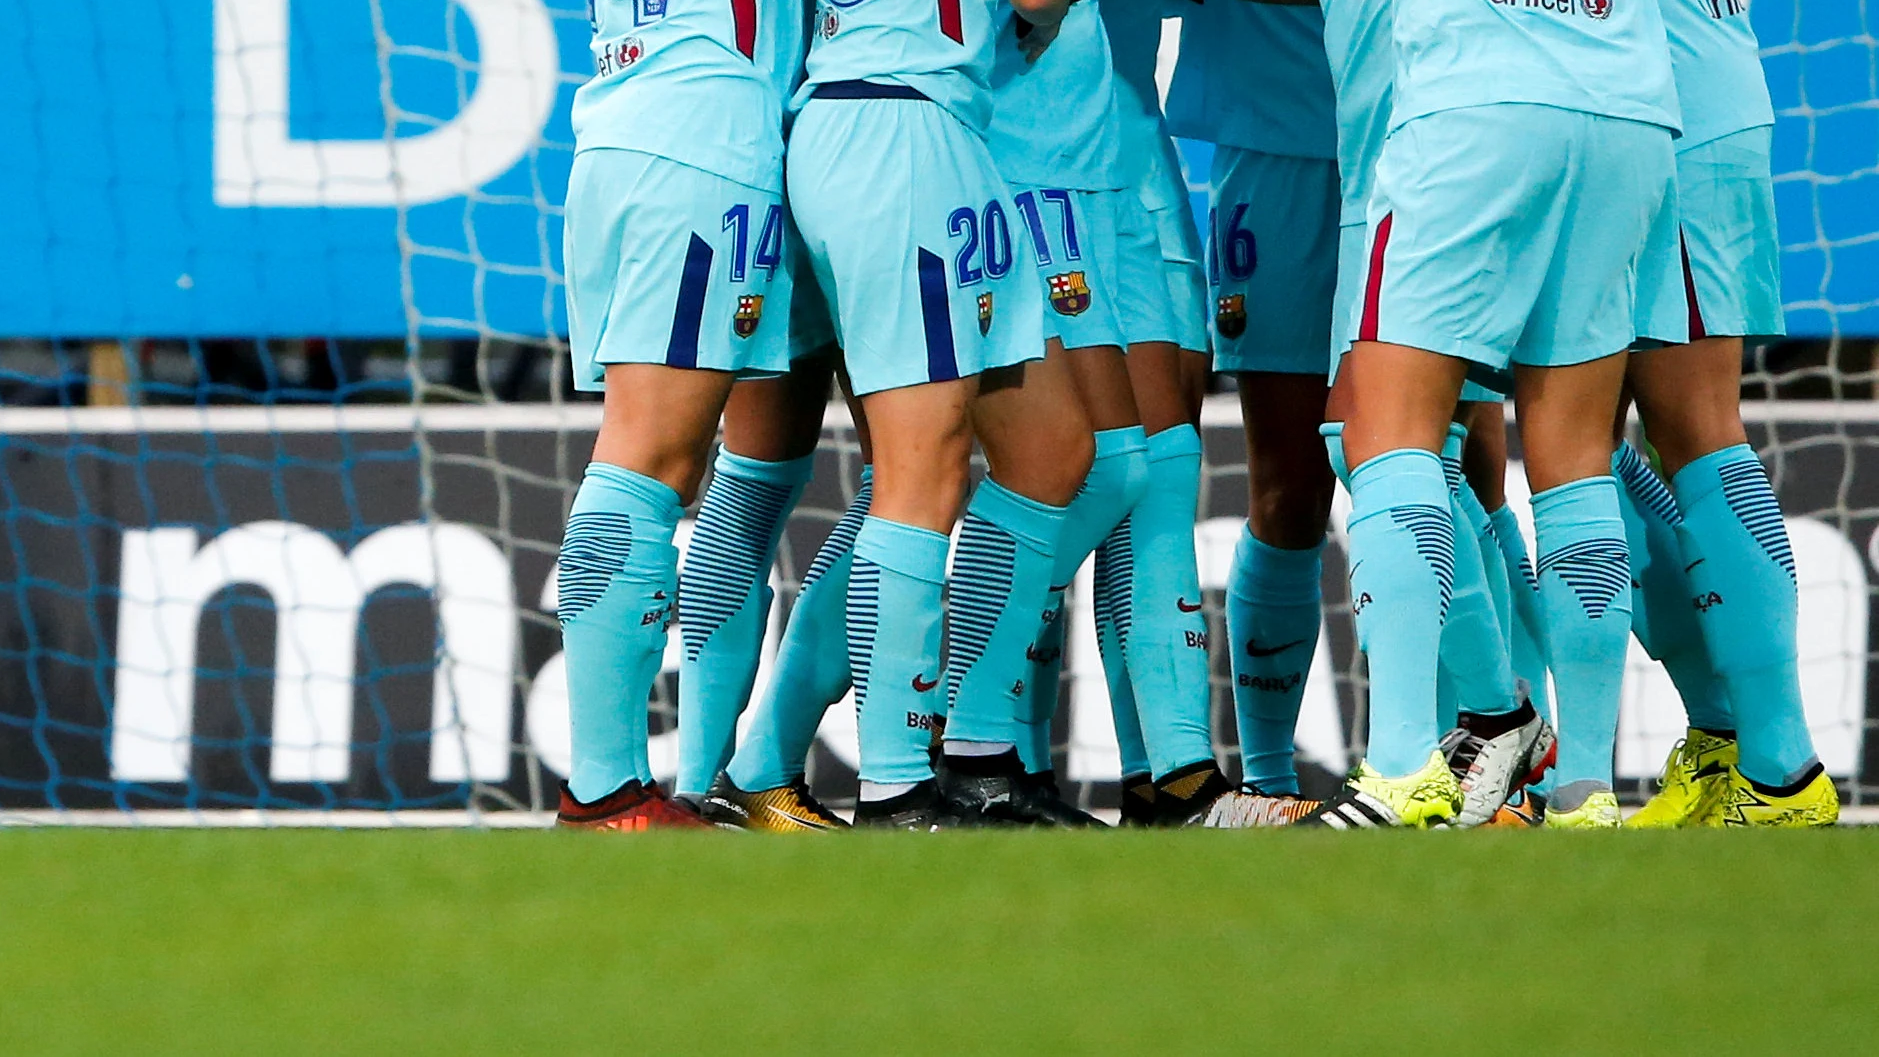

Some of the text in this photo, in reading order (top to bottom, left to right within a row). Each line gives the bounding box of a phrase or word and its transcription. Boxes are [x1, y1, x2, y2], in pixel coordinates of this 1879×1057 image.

[721, 203, 782, 283] 14
[947, 198, 1013, 289] 20
[1013, 188, 1082, 268] 17
[1209, 202, 1258, 286] 16
